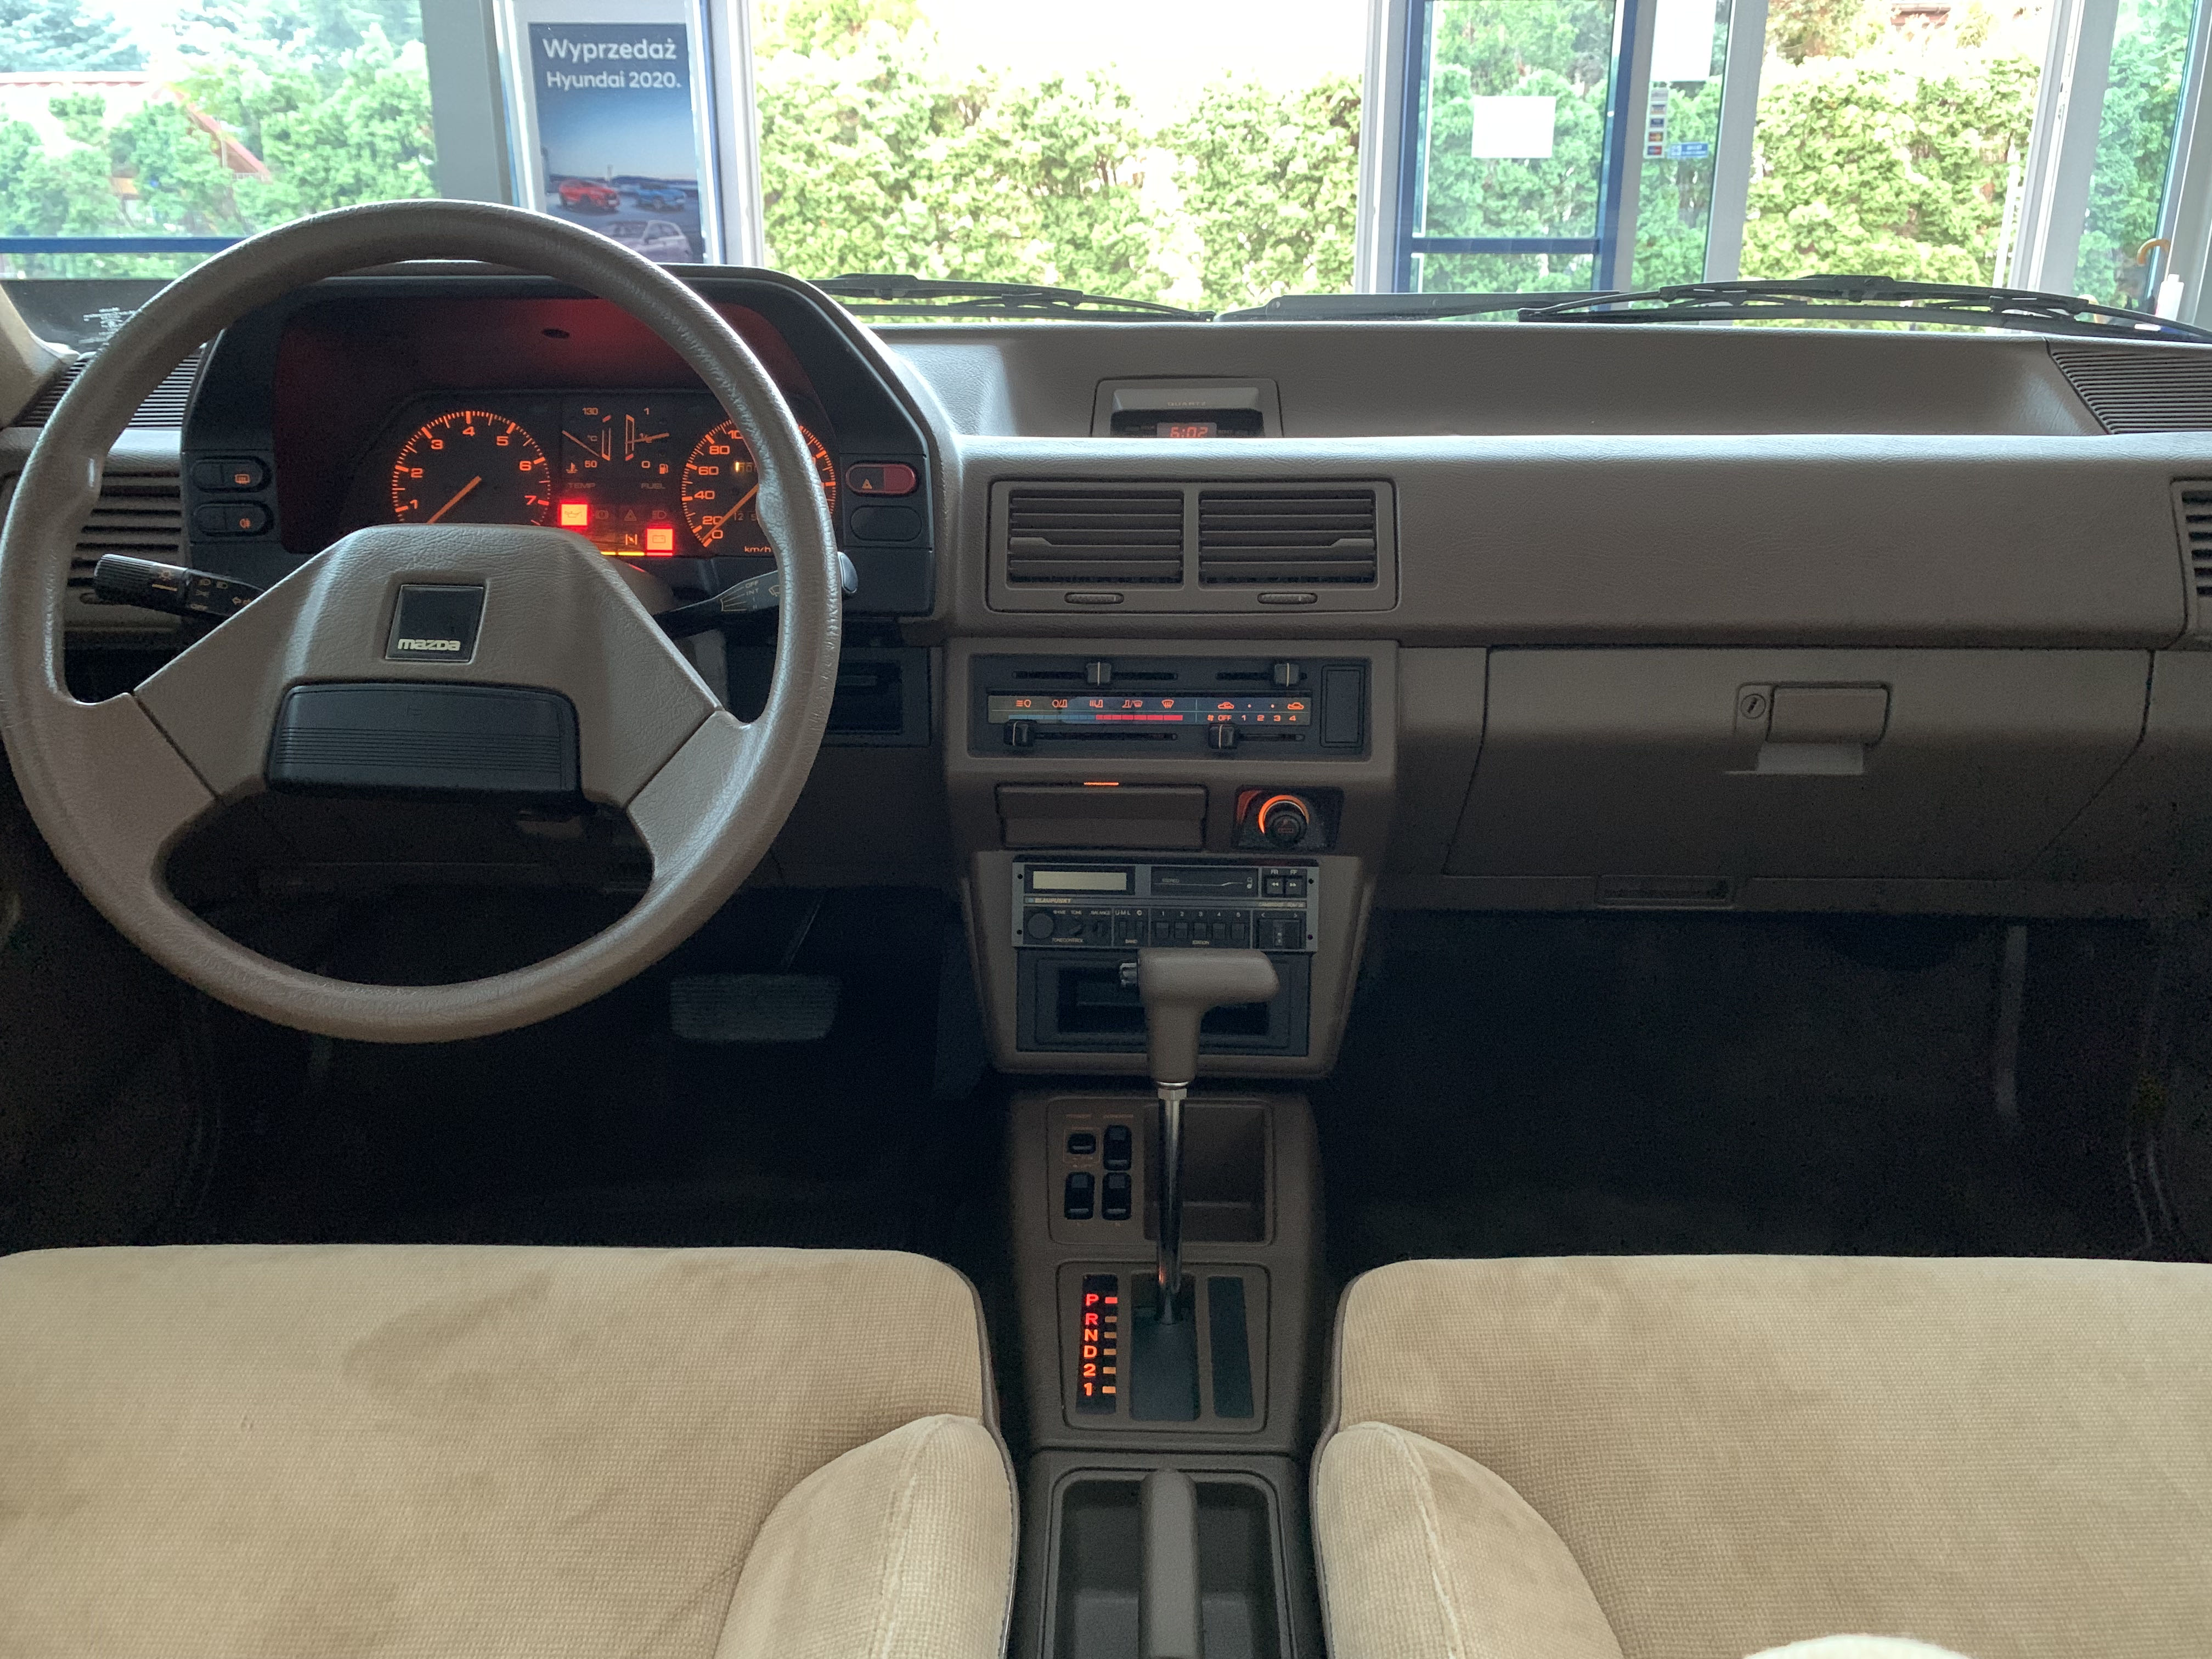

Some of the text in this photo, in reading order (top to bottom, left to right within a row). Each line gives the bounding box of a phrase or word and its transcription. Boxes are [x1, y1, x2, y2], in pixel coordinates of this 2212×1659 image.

[542, 38, 677, 64] Wyprzedaż
[546, 70, 682, 92] Hyundai 2020.
[462, 426, 475, 436] 4
[1170, 427, 1208, 438] 6:02
[431, 439, 443, 449] 3
[496, 436, 509, 446] 5
[709, 445, 730, 455] 80
[519, 461, 532, 471] 6
[698, 466, 719, 476] 60
[411, 468, 424, 478] 2
[524, 495, 537, 505] 7
[694, 490, 715, 500] 40
[410, 499, 417, 509] 1
[702, 516, 723, 525] 20
[712, 530, 723, 539] 0
[745, 580, 759, 589] OFF
[746, 588, 759, 596] INT
[397, 639, 461, 651] mazda
[1086, 1294, 1099, 1306] P
[1085, 1313, 1098, 1325] R
[1084, 1329, 1098, 1341] N
[1084, 1345, 1097, 1358] D
[1083, 1363, 1096, 1376] 2
[1084, 1383, 1092, 1396] 1
